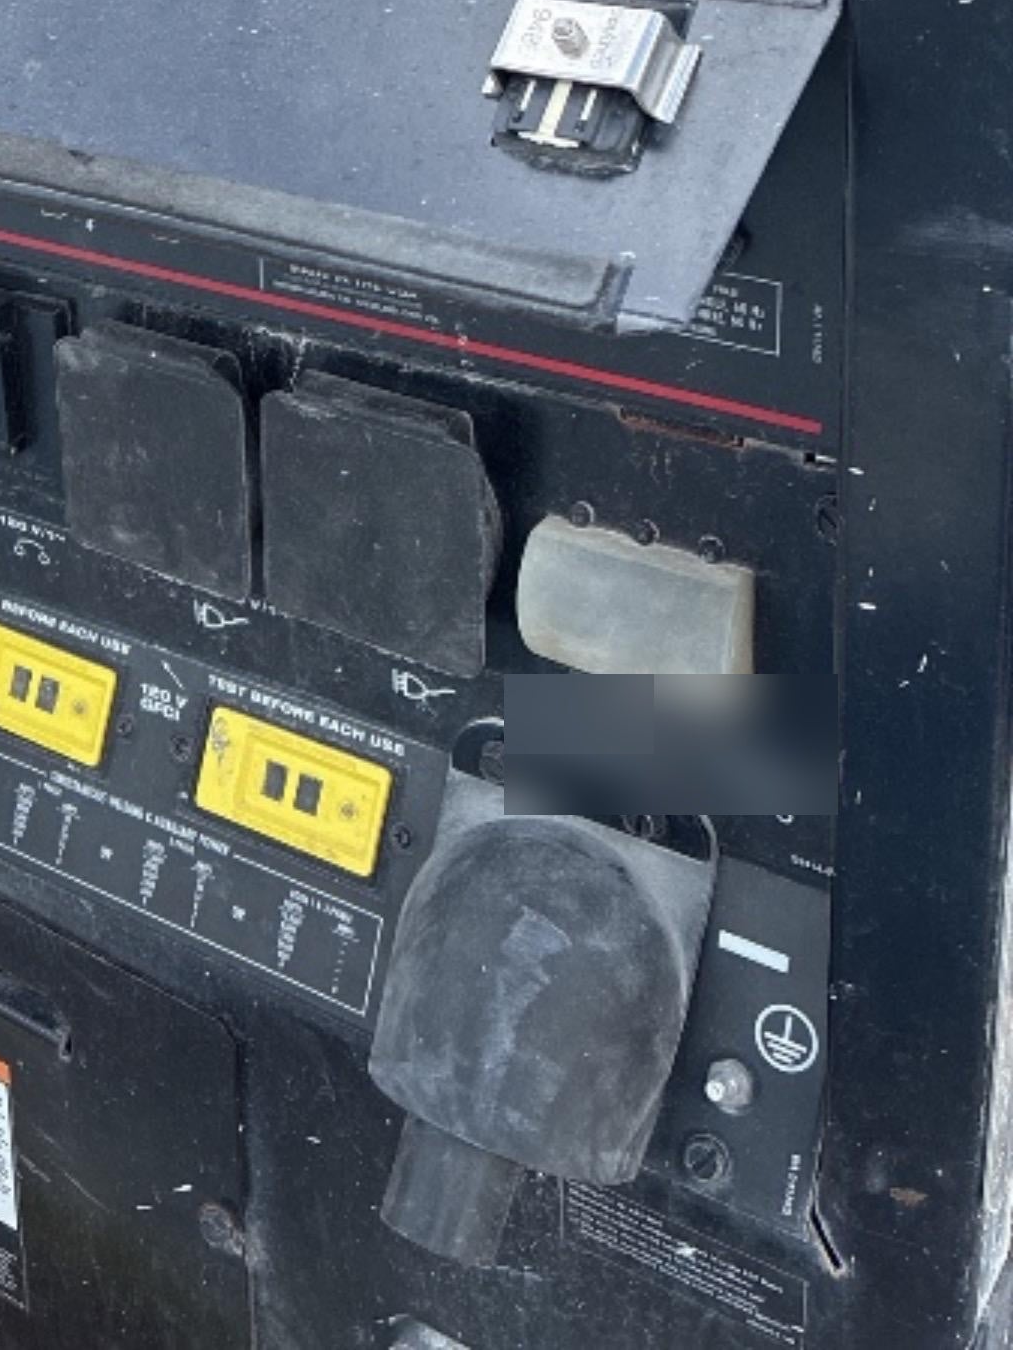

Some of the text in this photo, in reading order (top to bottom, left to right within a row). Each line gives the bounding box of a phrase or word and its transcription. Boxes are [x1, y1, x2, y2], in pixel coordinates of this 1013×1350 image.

[100, 634, 132, 655] USE
[208, 673, 406, 758] TEST BEFORE EACH USE
